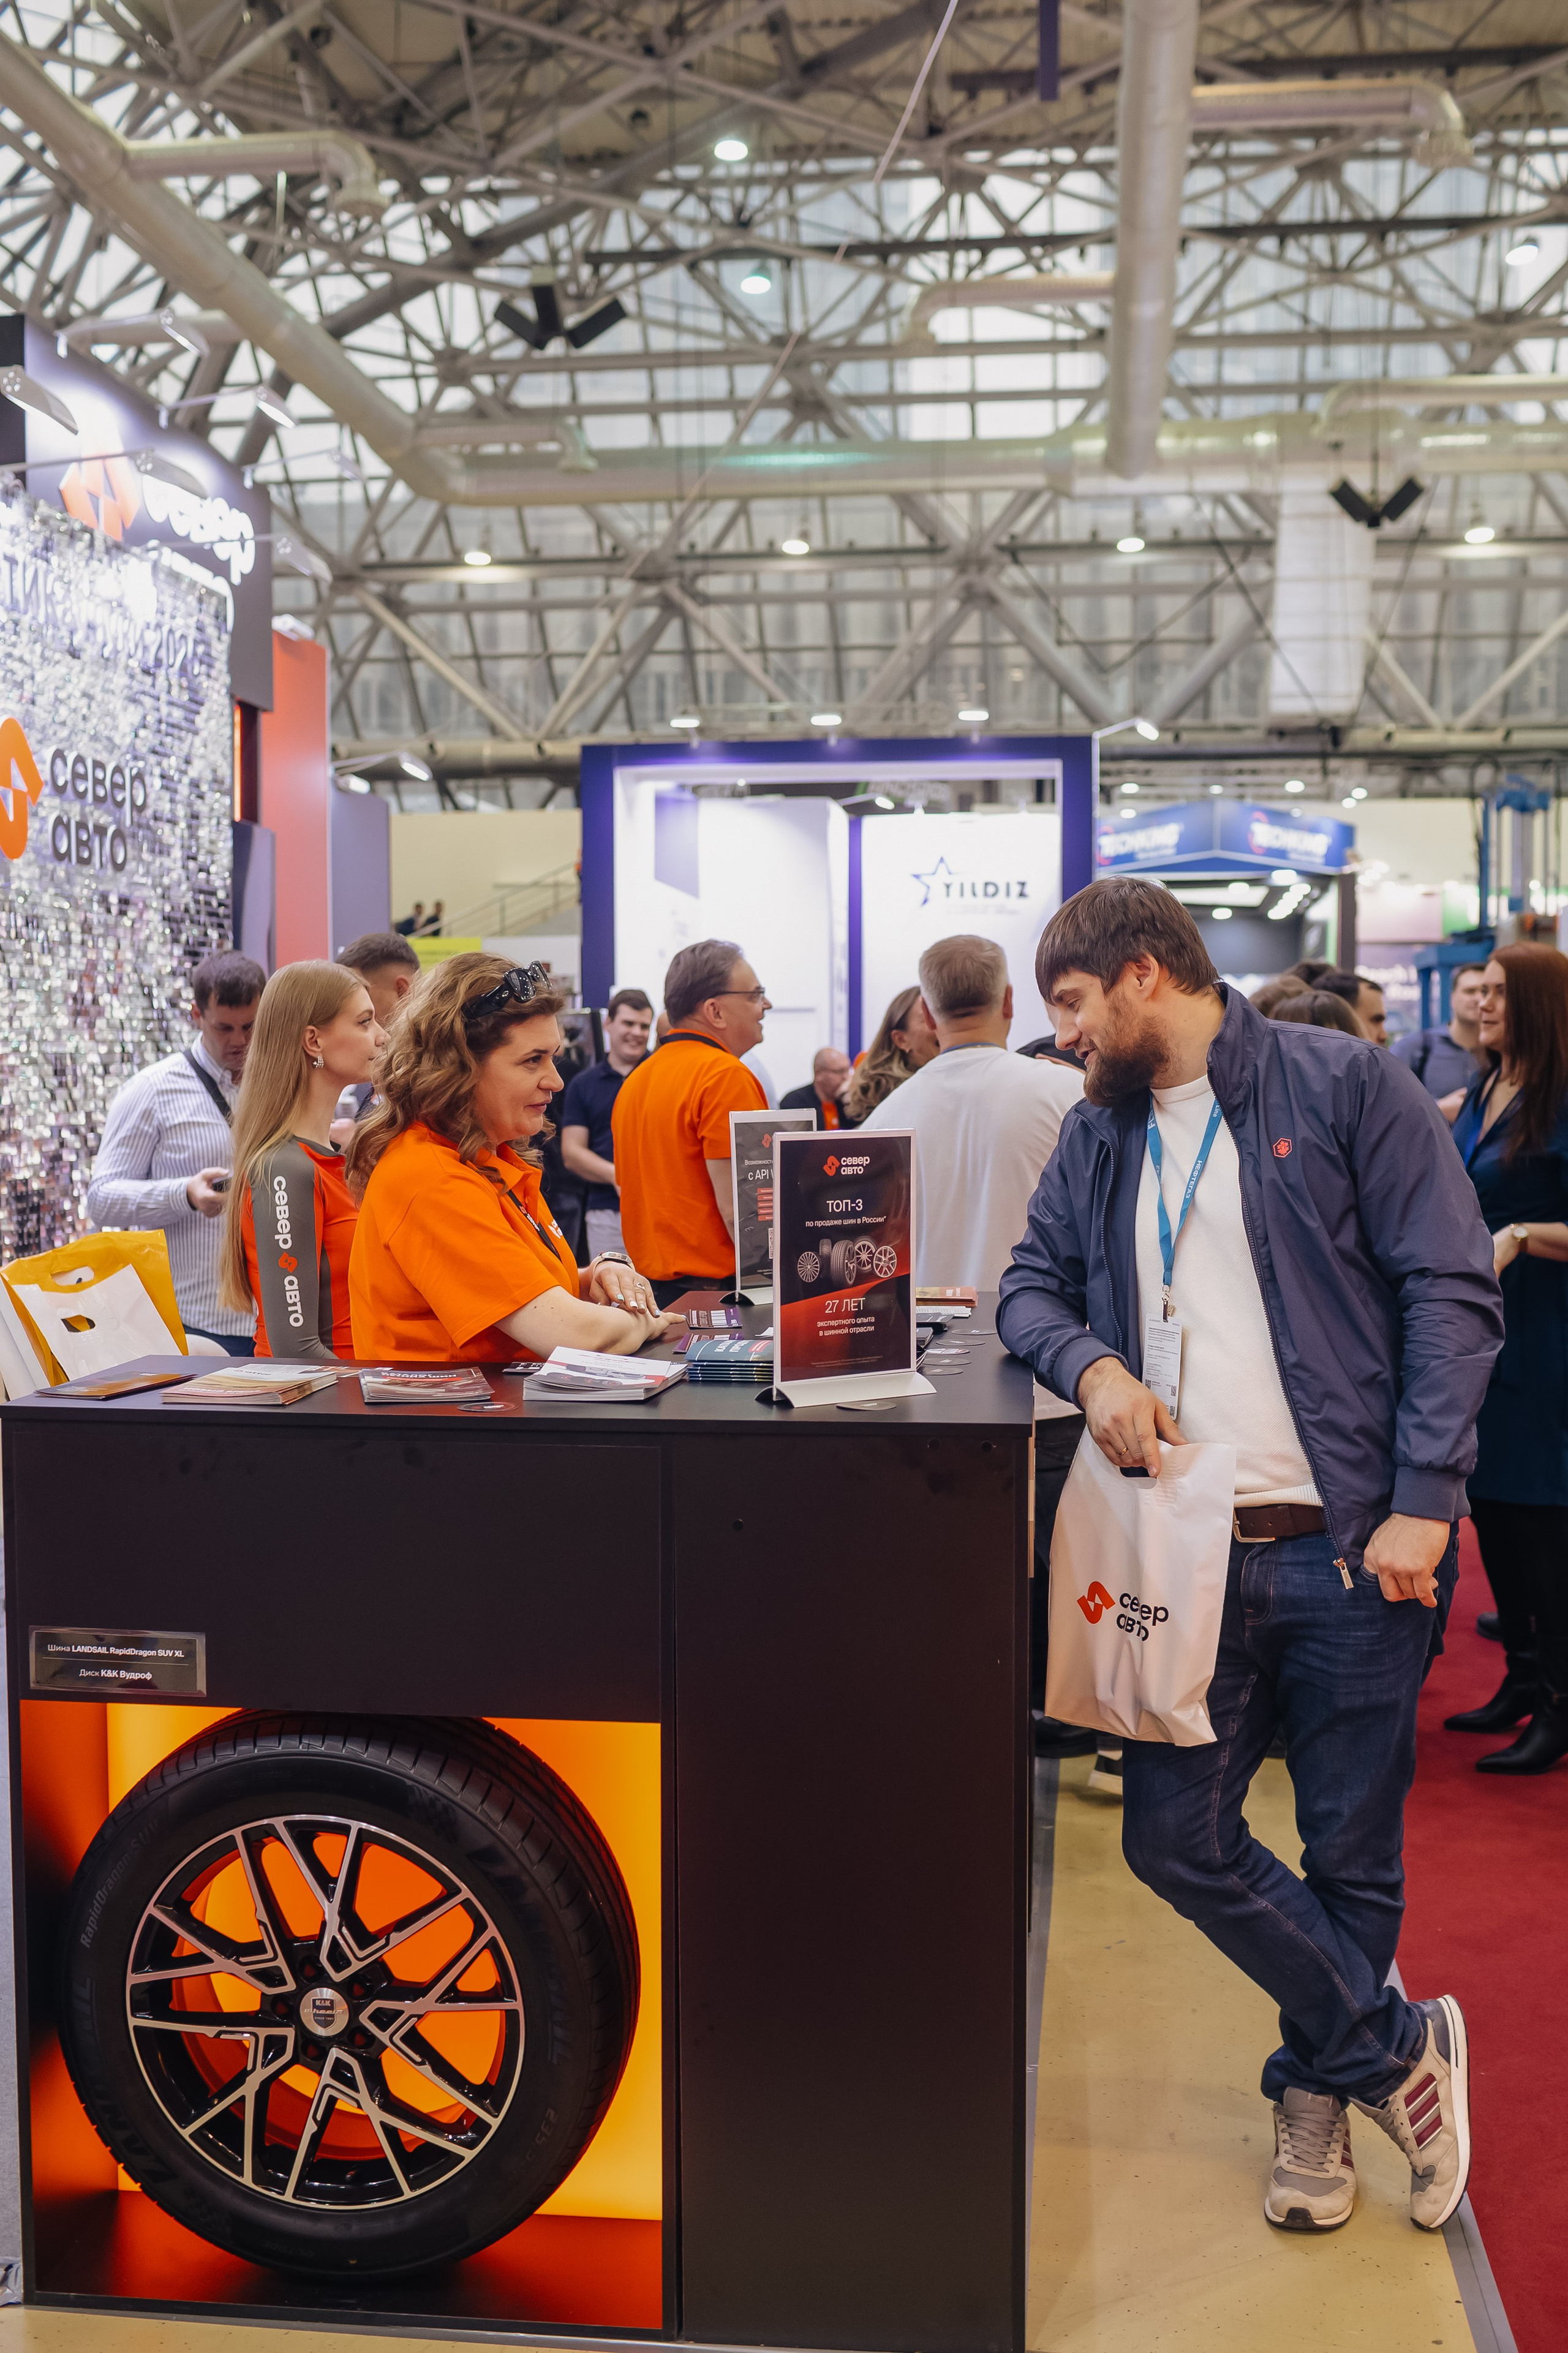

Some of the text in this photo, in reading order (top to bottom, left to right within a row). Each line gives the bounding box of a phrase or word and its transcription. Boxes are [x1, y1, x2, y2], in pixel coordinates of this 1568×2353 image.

[50, 748, 147, 826] север
[52, 815, 127, 872] авто
[943, 881, 1030, 897] YILDIZ
[841, 1156, 870, 1166] север
[755, 1169, 769, 1180] API
[841, 1166, 864, 1175] авто
[1185, 1160, 1202, 1199] НЕФТЕГАЗ
[826, 1199, 863, 1212] ТОП-3
[815, 1219, 842, 1228] продаже
[273, 1176, 304, 1328] север авто
[825, 1297, 865, 1313] 27 ЛЕТ
[817, 1318, 855, 1327] экспертного
[824, 1327, 848, 1335] шинной
[72, 1645, 109, 1653] LANDSAIL
[110, 1647, 157, 1657] RapidDragon
[119, 1670, 153, 1680] Вудроф
